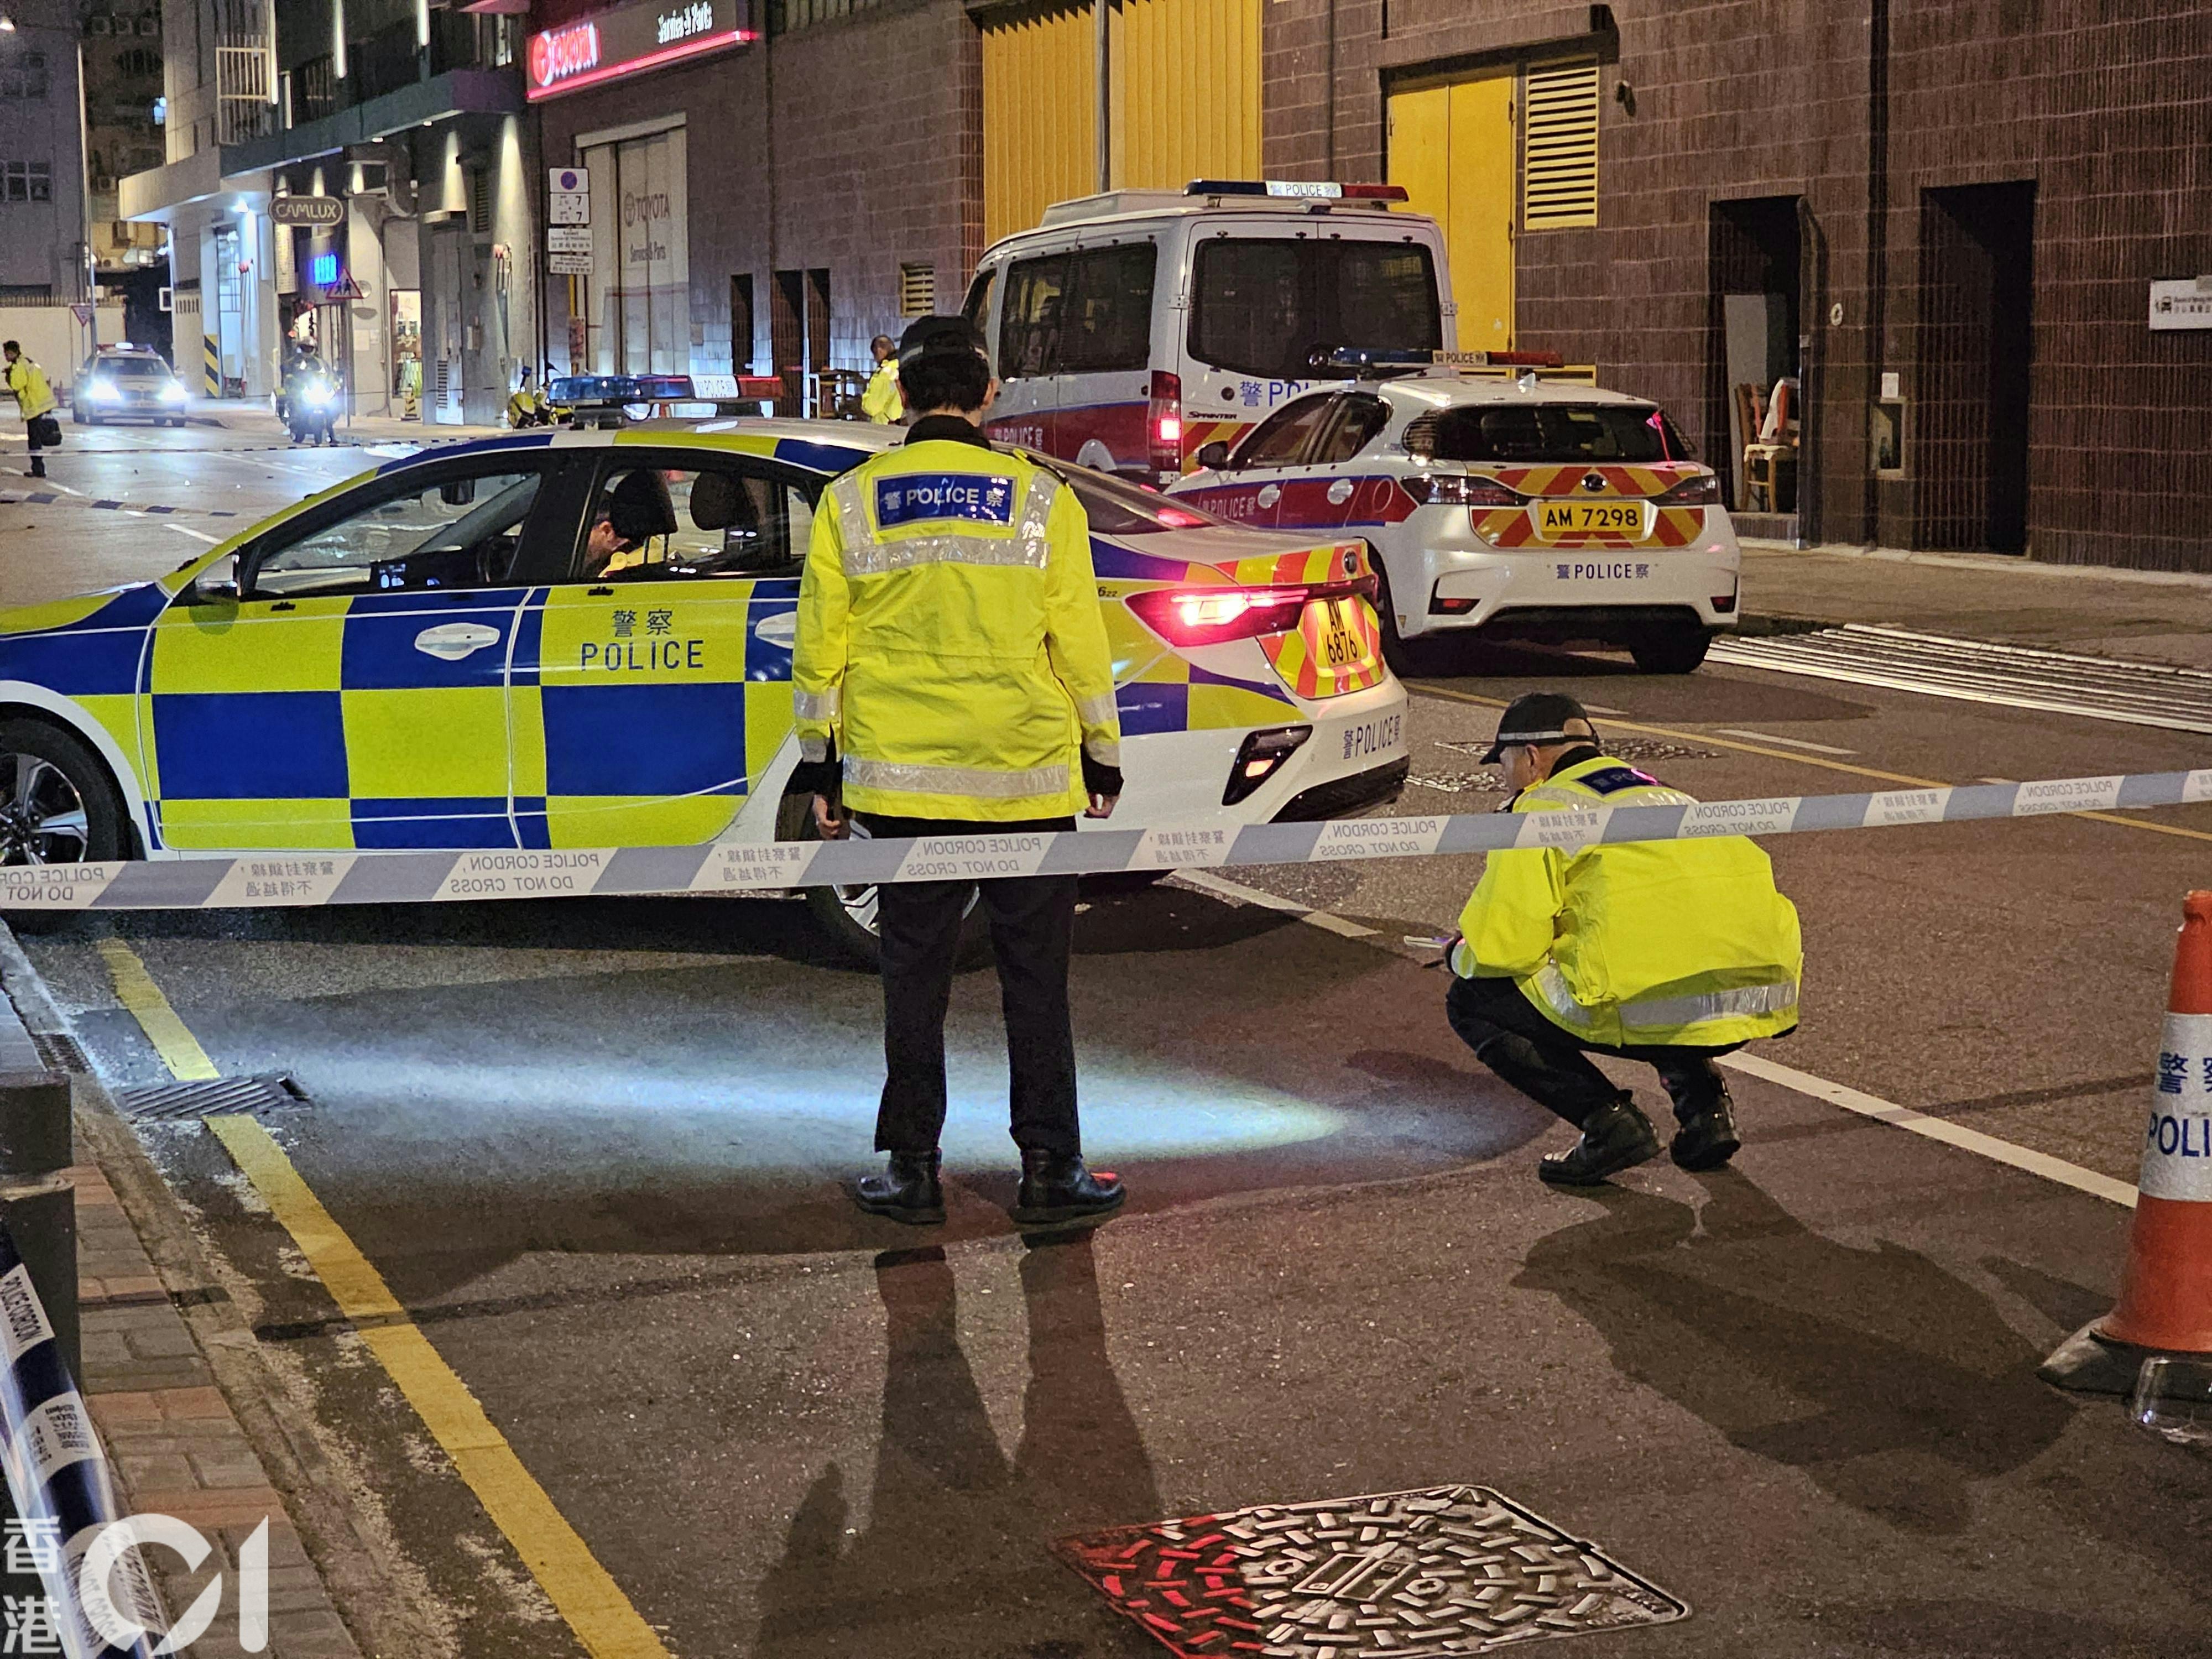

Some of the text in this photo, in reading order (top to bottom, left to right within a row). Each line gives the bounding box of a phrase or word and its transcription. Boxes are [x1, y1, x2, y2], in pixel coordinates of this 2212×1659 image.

[1285, 184, 1322, 196] POLICE
[276, 204, 336, 218] CAMLUX
[636, 194, 670, 221] TOYOTA
[1446, 352, 1473, 363] POLICE
[1240, 381, 1262, 406] 警
[907, 488, 979, 506] POLICE
[1211, 497, 1246, 518] POLICE
[1546, 509, 1638, 526] AM 7298
[1575, 564, 1631, 579] POLICE
[1636, 564, 1649, 578] 察
[612, 609, 672, 637] 警察
[1327, 598, 1344, 632] AM
[582, 640, 703, 671] POLICE
[1327, 630, 1357, 663] 6876
[1355, 716, 1392, 757] POLICE
[2147, 1111, 2210, 1157] POLI
